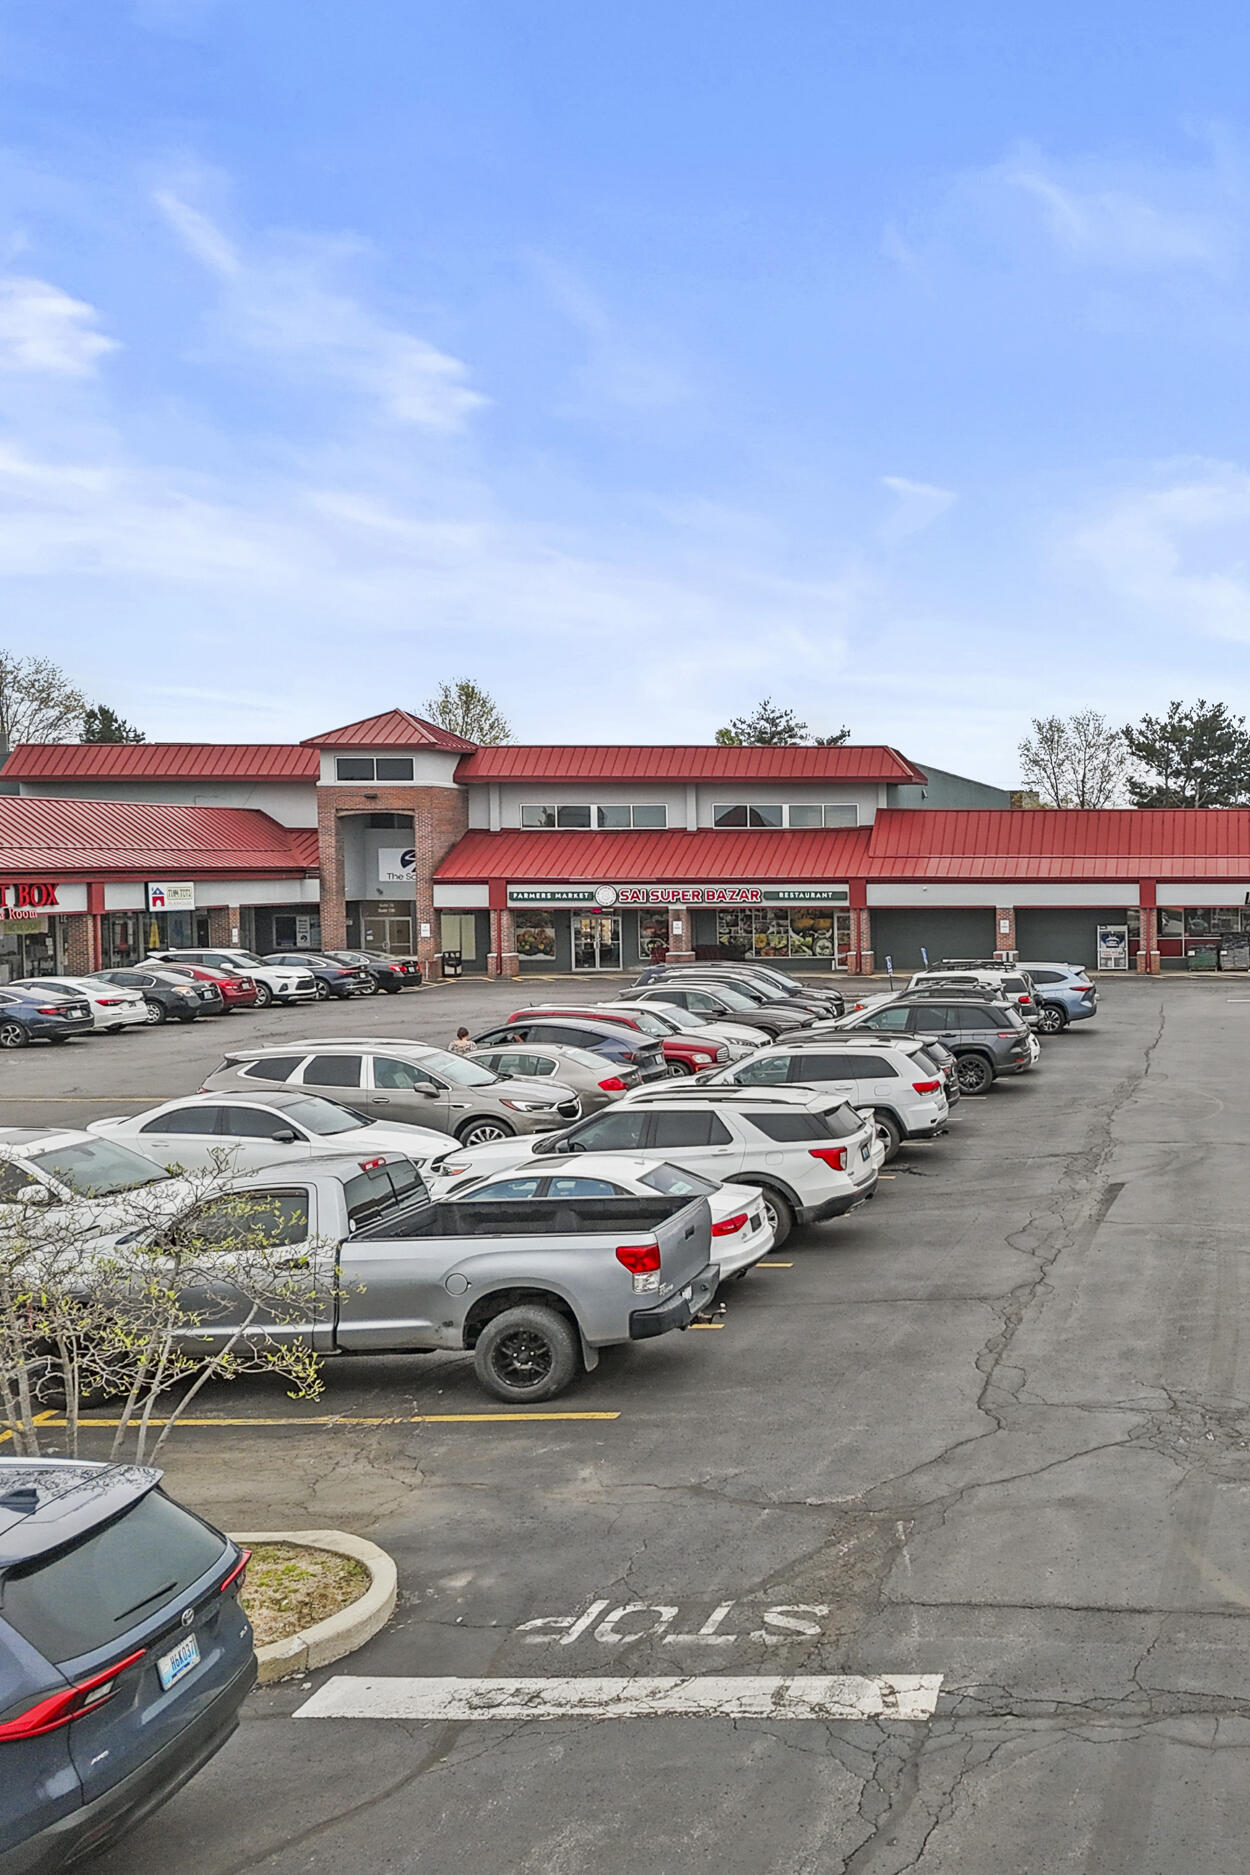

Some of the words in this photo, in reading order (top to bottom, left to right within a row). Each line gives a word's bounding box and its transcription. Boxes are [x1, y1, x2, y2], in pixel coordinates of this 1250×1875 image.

[387, 872, 404, 880] The
[15, 883, 60, 907] BOX
[513, 891, 551, 900] FARMERS
[618, 888, 647, 903] SAI
[649, 888, 702, 903] SUPER
[704, 888, 762, 903] BAZAR
[8, 907, 38, 920] Room
[515, 1599, 832, 1646] STOP
